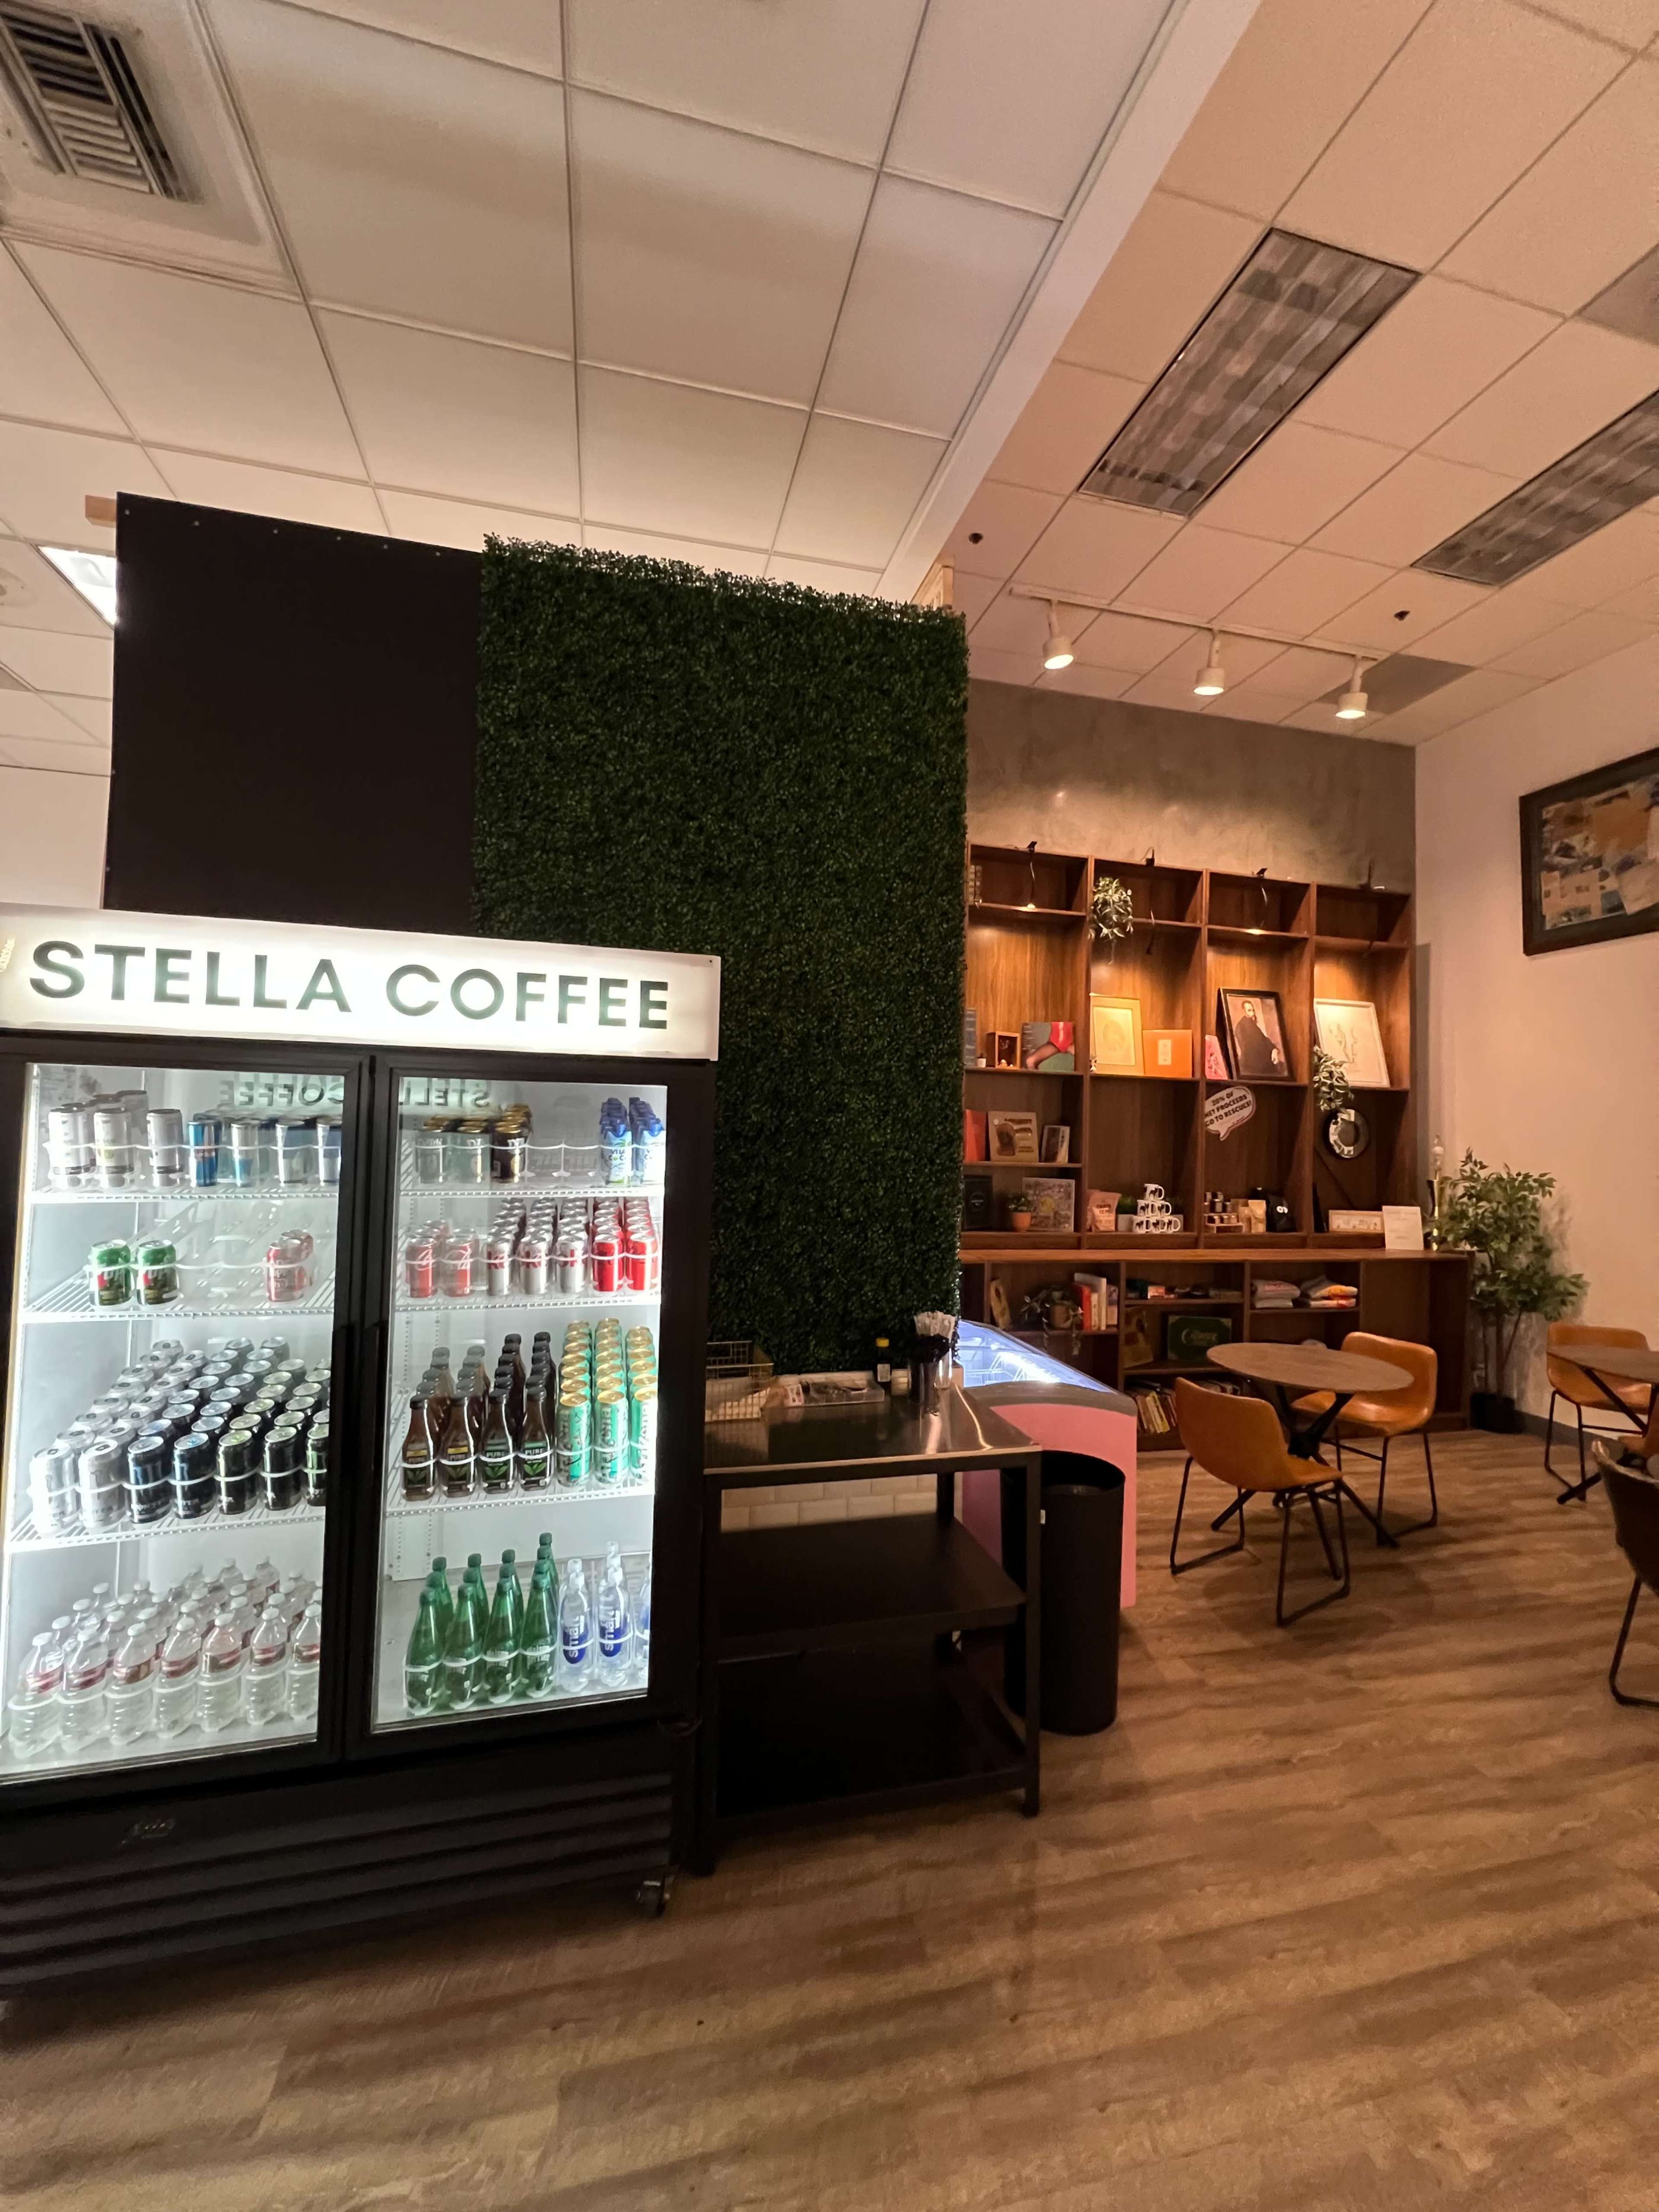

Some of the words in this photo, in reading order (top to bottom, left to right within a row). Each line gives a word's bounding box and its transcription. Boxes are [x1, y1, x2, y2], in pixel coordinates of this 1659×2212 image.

[29, 940, 352, 1013] STELLA
[386, 964, 669, 1029] COFFEE
[1216, 1094, 1247, 1112] PROCEEDS
